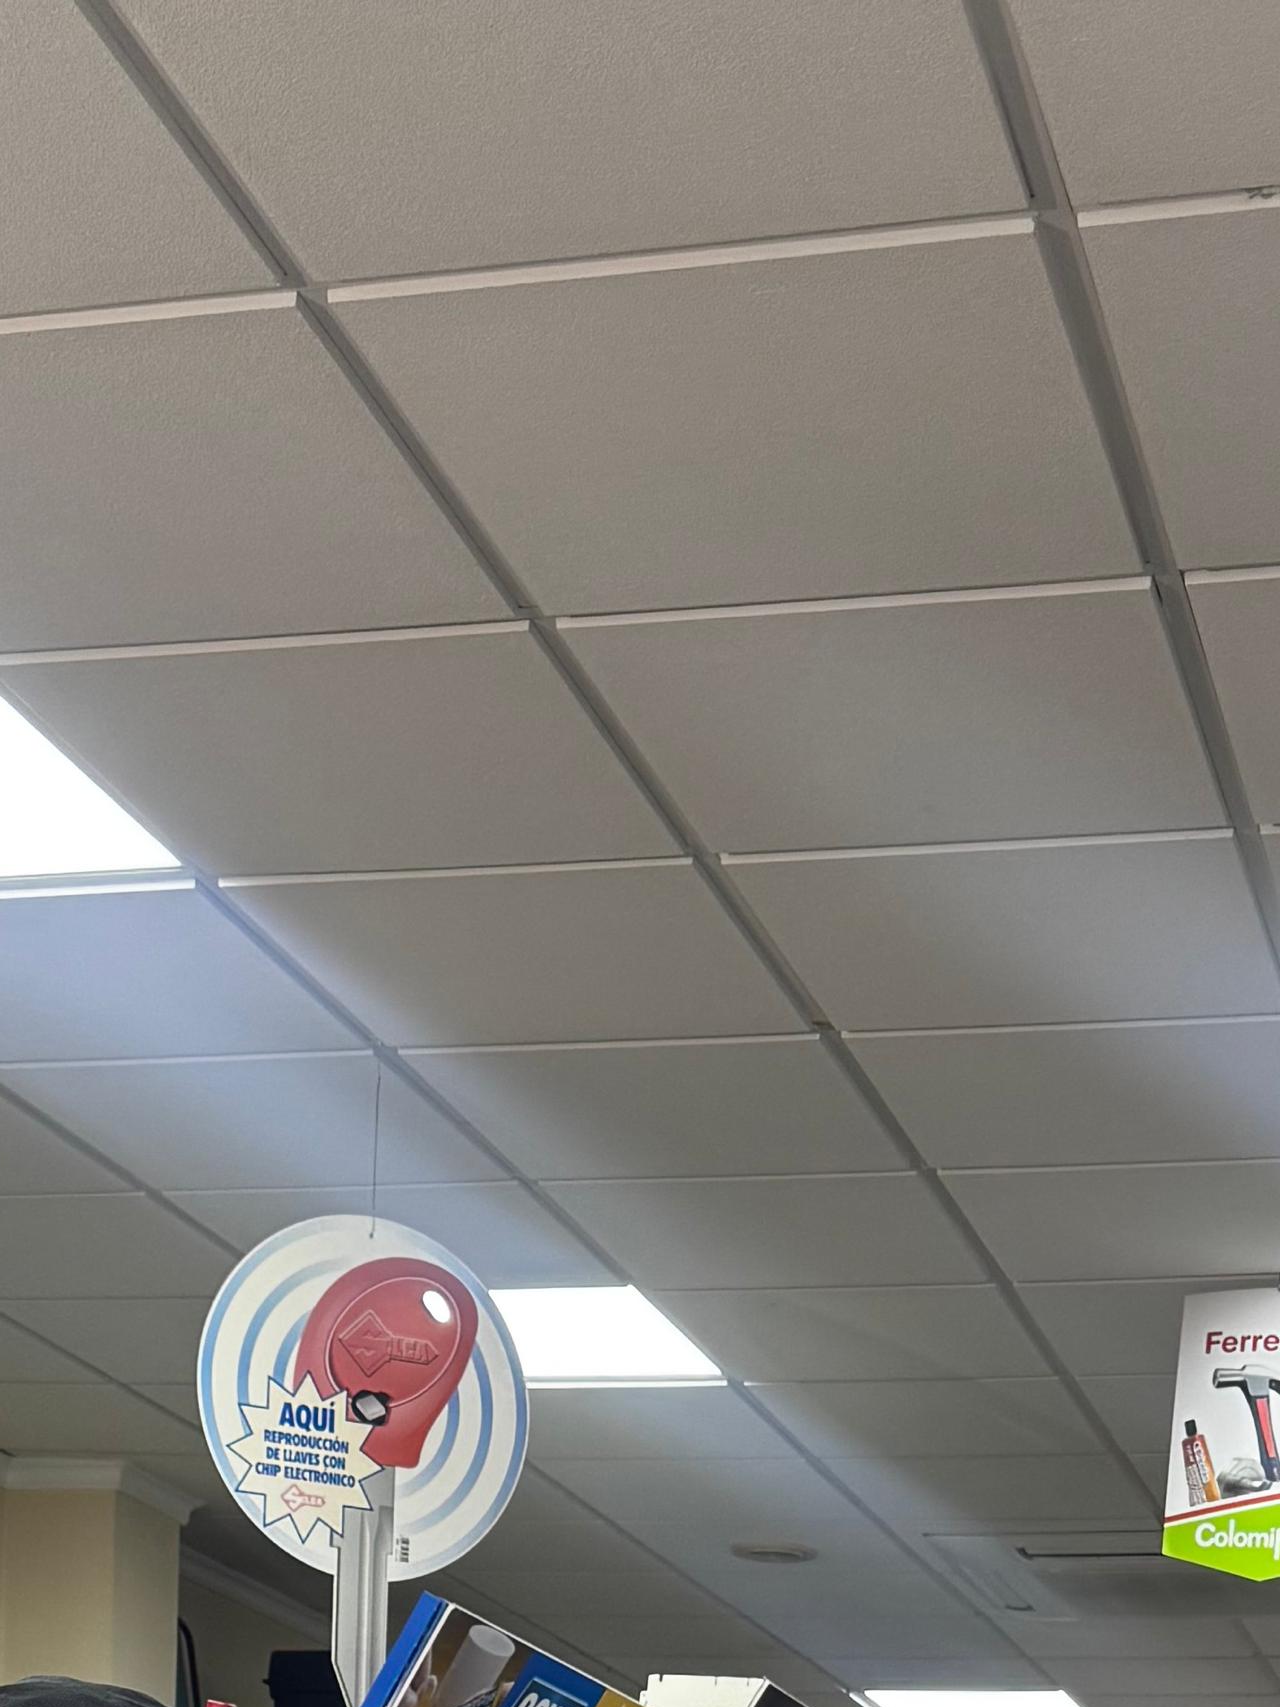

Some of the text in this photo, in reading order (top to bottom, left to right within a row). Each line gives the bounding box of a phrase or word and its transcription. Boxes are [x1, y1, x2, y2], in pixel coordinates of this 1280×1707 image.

[279, 1401, 335, 1433] AQUÍ
[264, 1429, 349, 1454] REPRODUCCIÓN
[266, 1446, 346, 1470] DE LLAVES CON
[255, 1462, 356, 1488] CHIP ELECTRÓNICO
